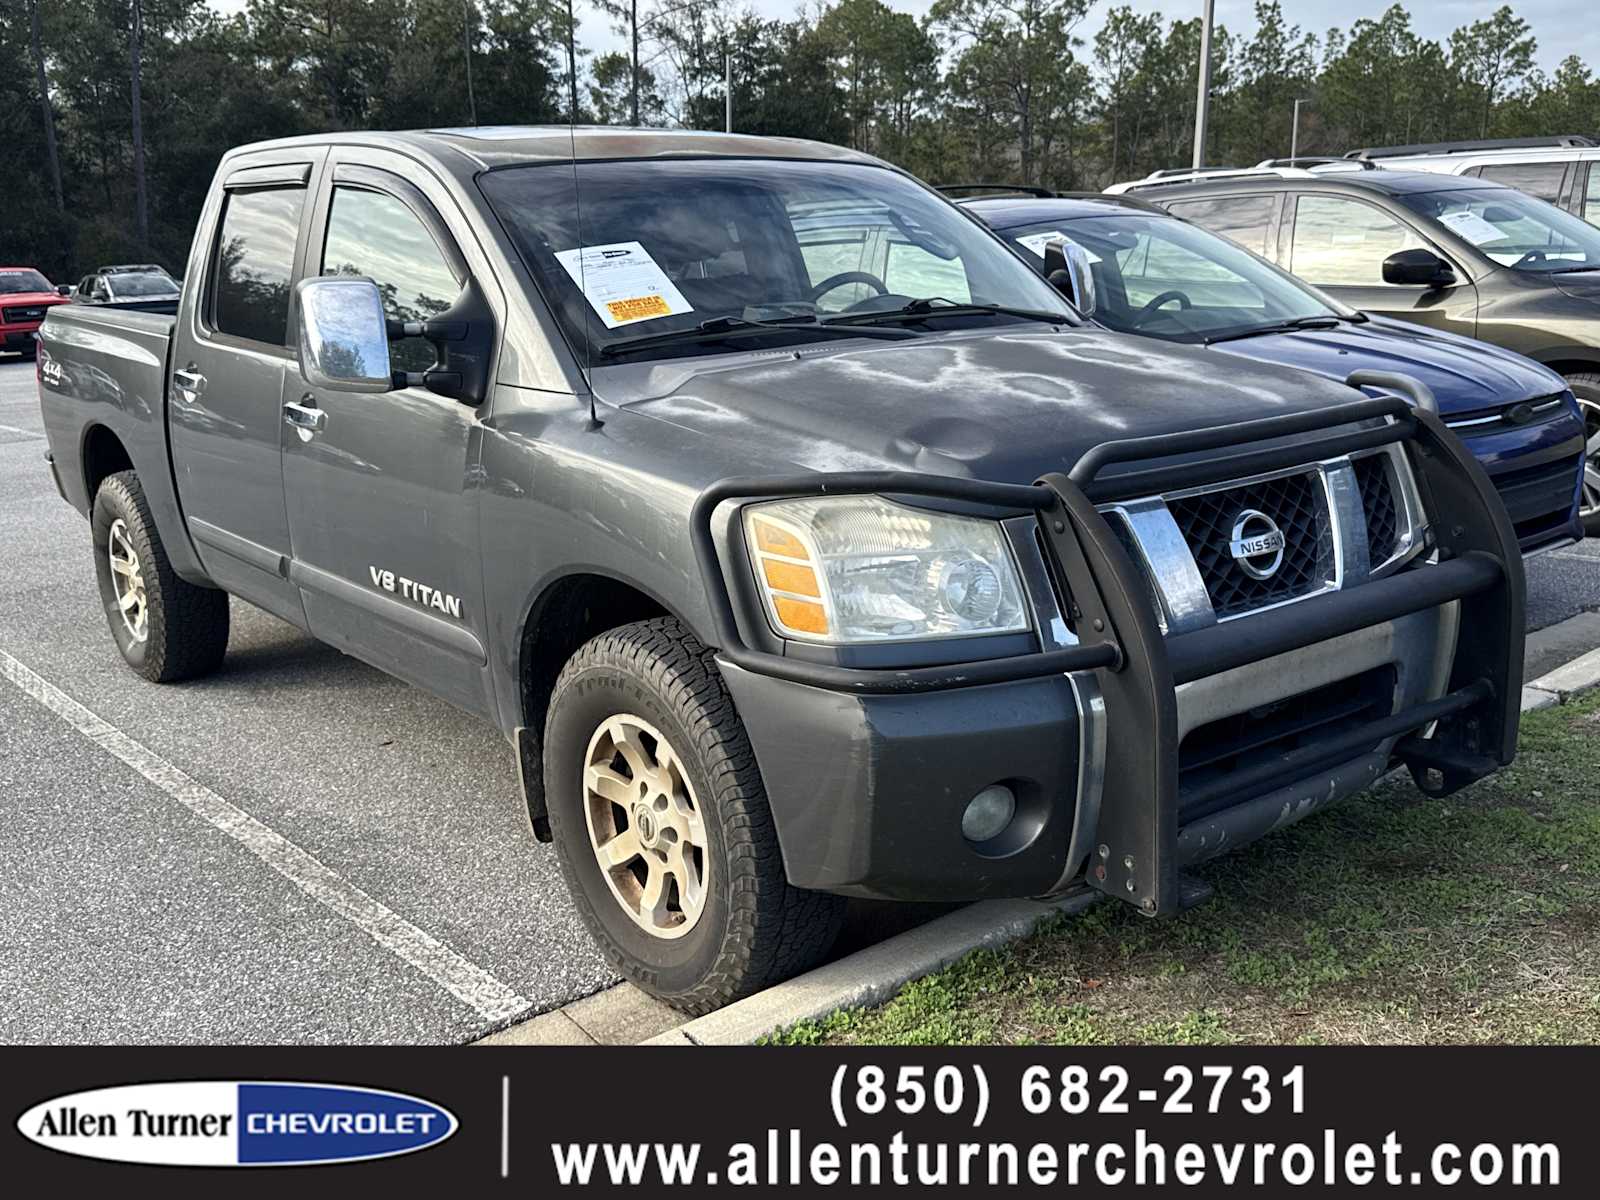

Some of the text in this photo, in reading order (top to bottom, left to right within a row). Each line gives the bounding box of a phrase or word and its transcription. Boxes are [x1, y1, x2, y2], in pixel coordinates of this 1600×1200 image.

[1240, 535, 1283, 554] NISSAN
[369, 566, 461, 618] V8 TITAN
